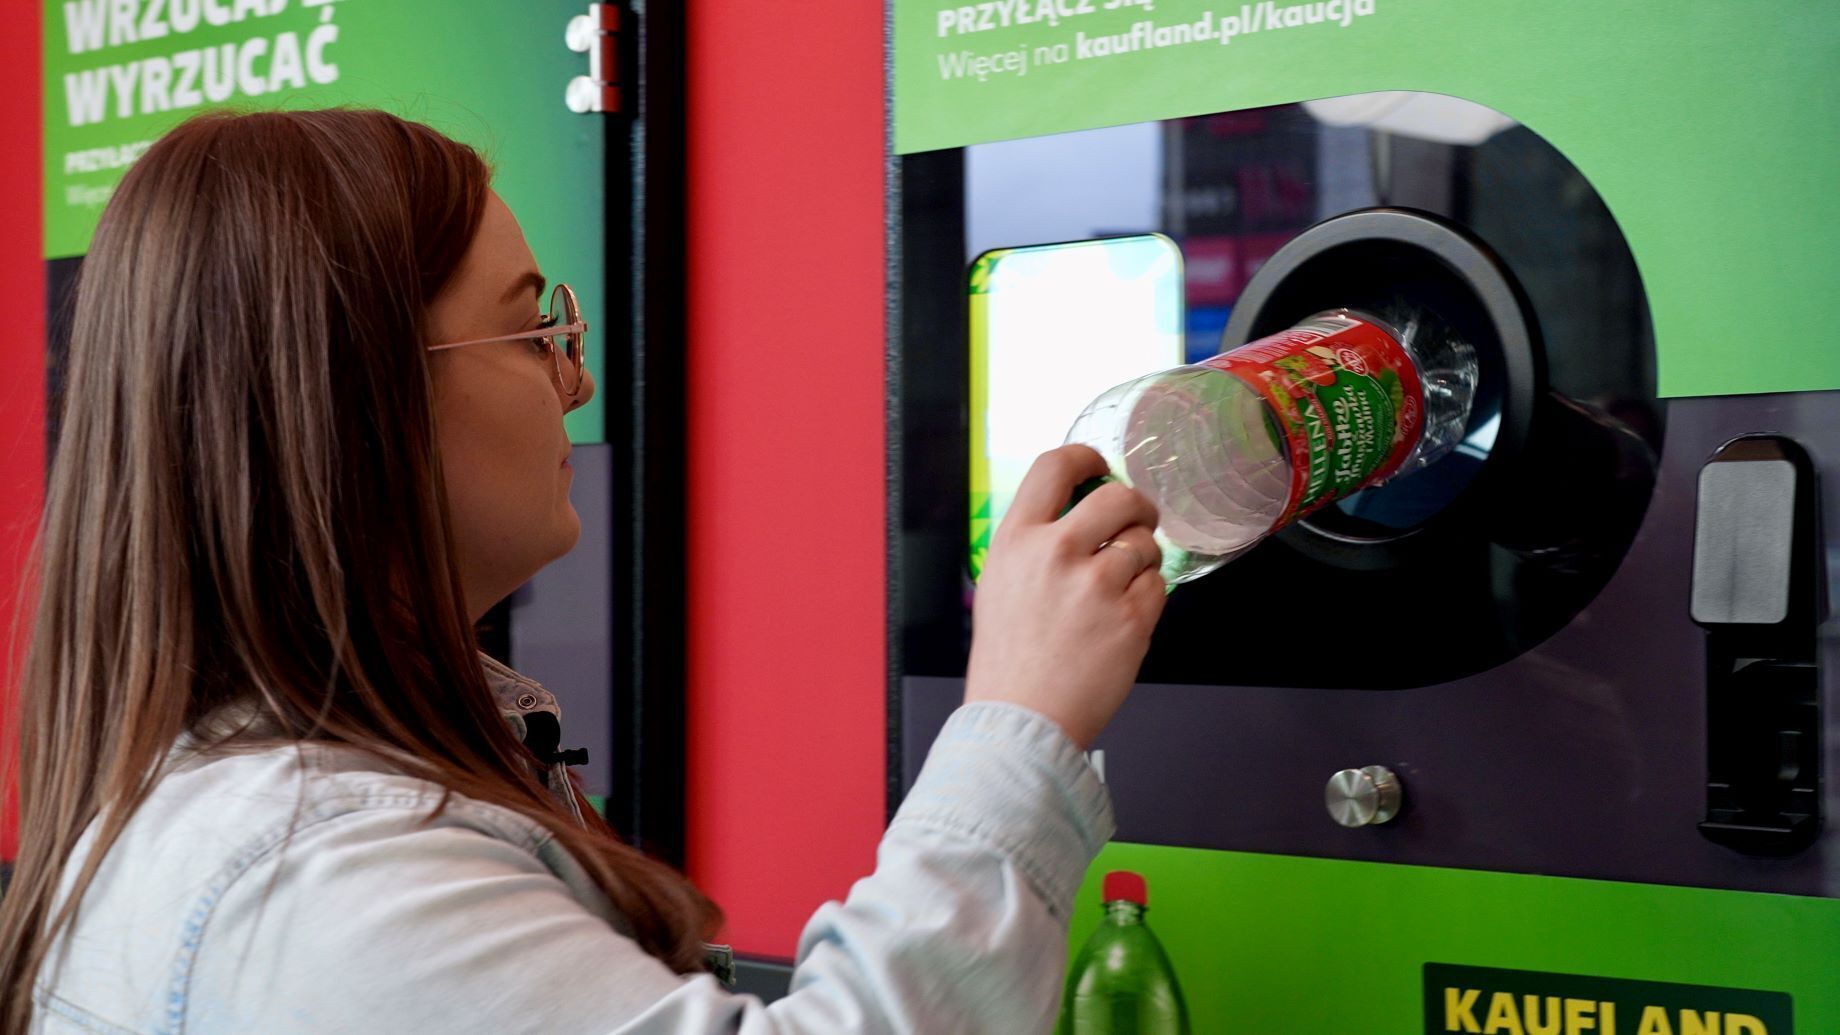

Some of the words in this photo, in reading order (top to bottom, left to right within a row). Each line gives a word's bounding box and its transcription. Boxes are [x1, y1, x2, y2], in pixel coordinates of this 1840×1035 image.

[63, 4, 341, 127] WYRZUCAĆ
[937, 44, 1029, 82] Więcej
[1033, 42, 1071, 66] na
[1075, 0, 1376, 60] kaufland.pl/kaucja
